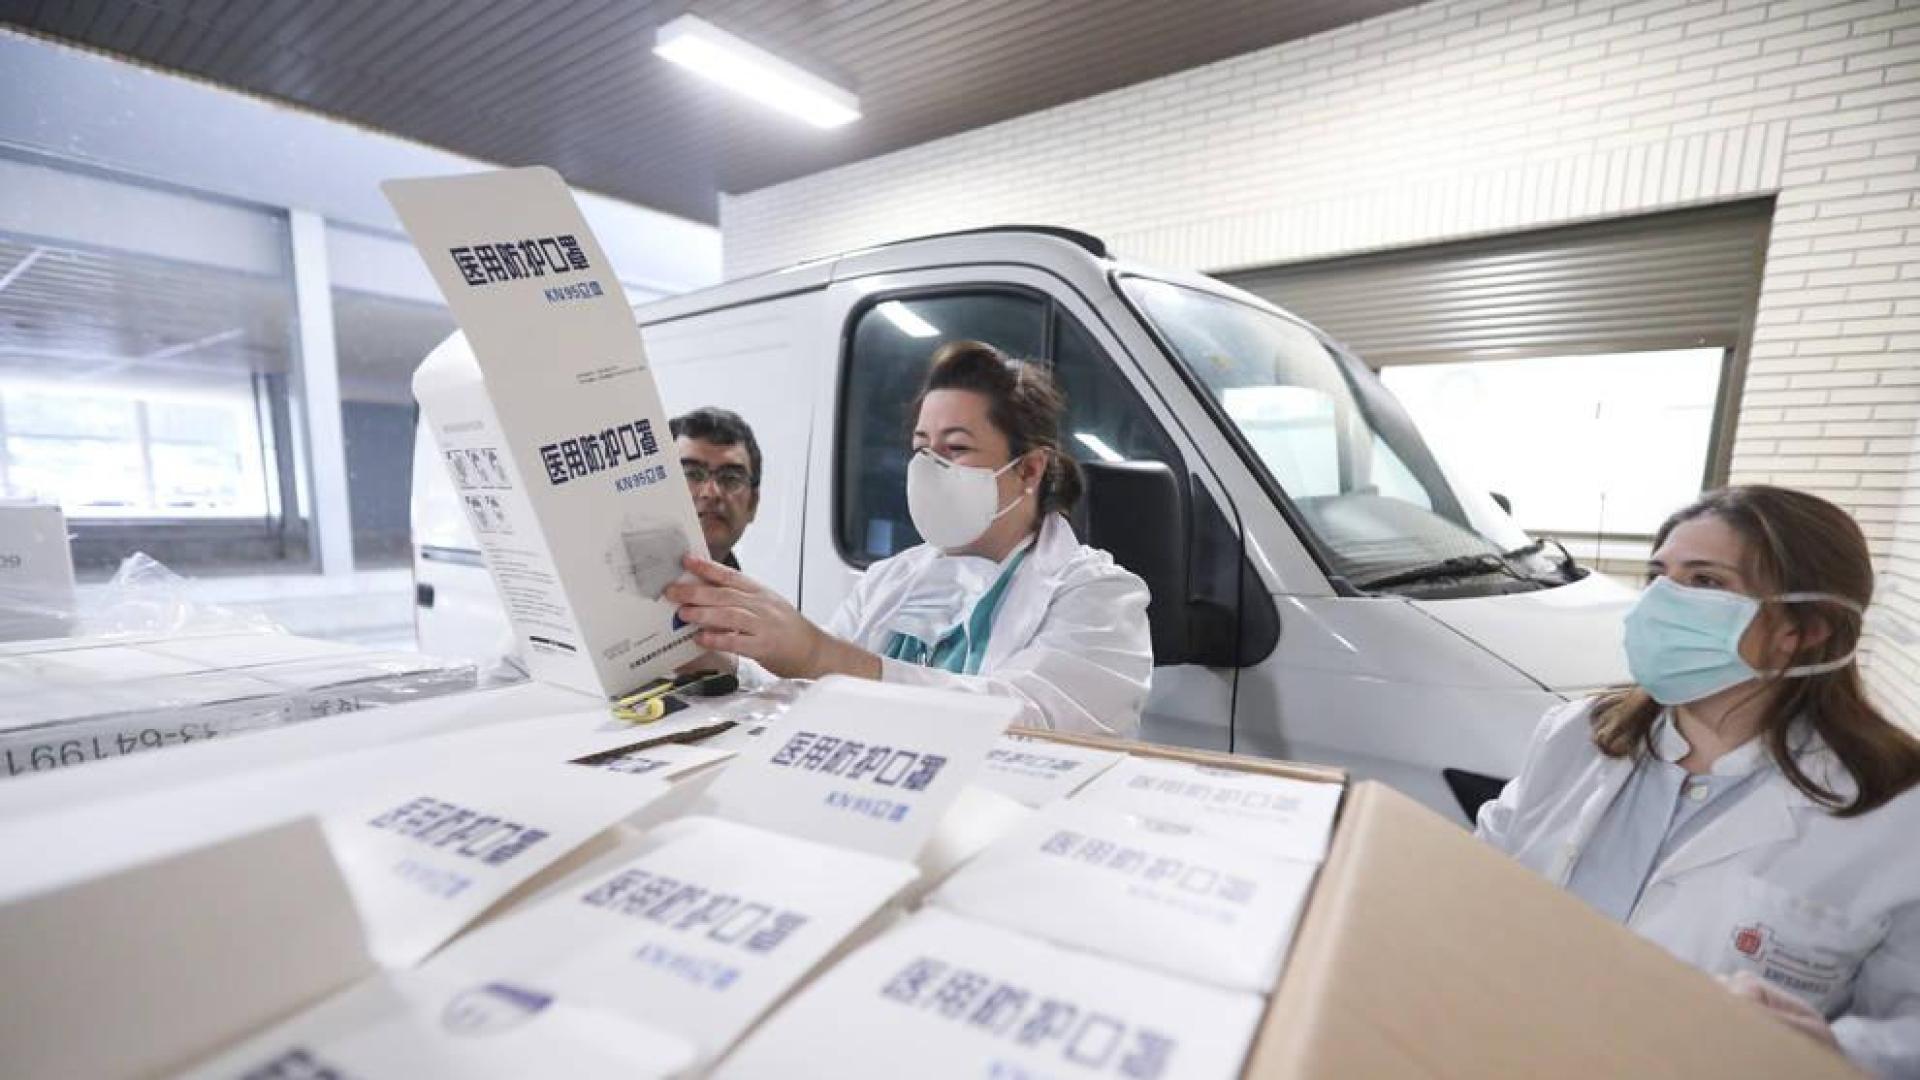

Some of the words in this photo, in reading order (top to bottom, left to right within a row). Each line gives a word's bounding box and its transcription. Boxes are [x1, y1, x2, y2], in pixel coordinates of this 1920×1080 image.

[449, 234, 591, 286] 医用防护口罩
[539, 418, 660, 485] 医用防护口罩
[770, 731, 949, 791] 医用防护口罩
[368, 796, 550, 866] 医用防护口罩
[580, 867, 811, 953] 医用防护口罩
[878, 954, 1180, 1080] 医用防护口罩
